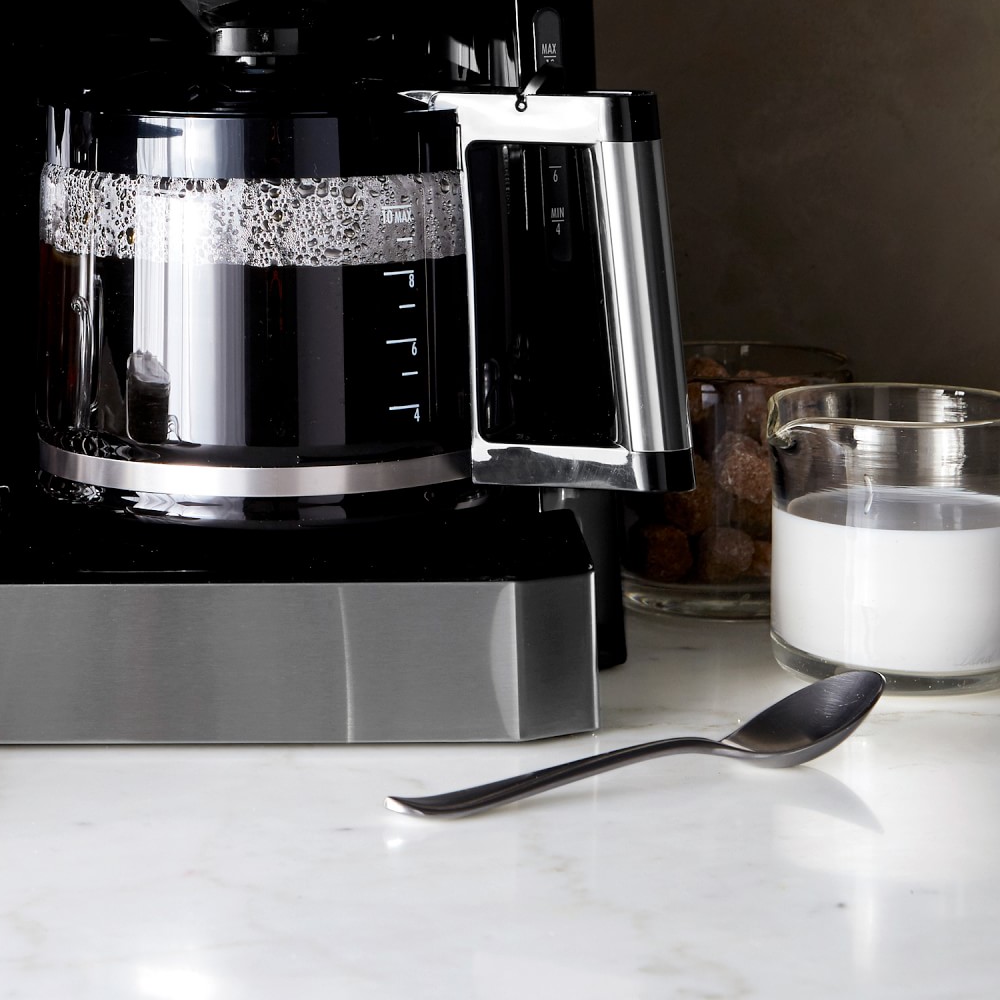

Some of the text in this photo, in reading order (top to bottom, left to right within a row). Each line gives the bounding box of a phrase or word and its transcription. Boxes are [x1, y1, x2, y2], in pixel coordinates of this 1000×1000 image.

[541, 42, 557, 55] MAX
[552, 169, 559, 183] 6
[394, 209, 412, 224] MAX
[550, 207, 565, 219] MIN
[555, 223, 561, 236] 4
[408, 273, 415, 288] 8
[411, 341, 418, 356] 6
[413, 407, 421, 423] 4
